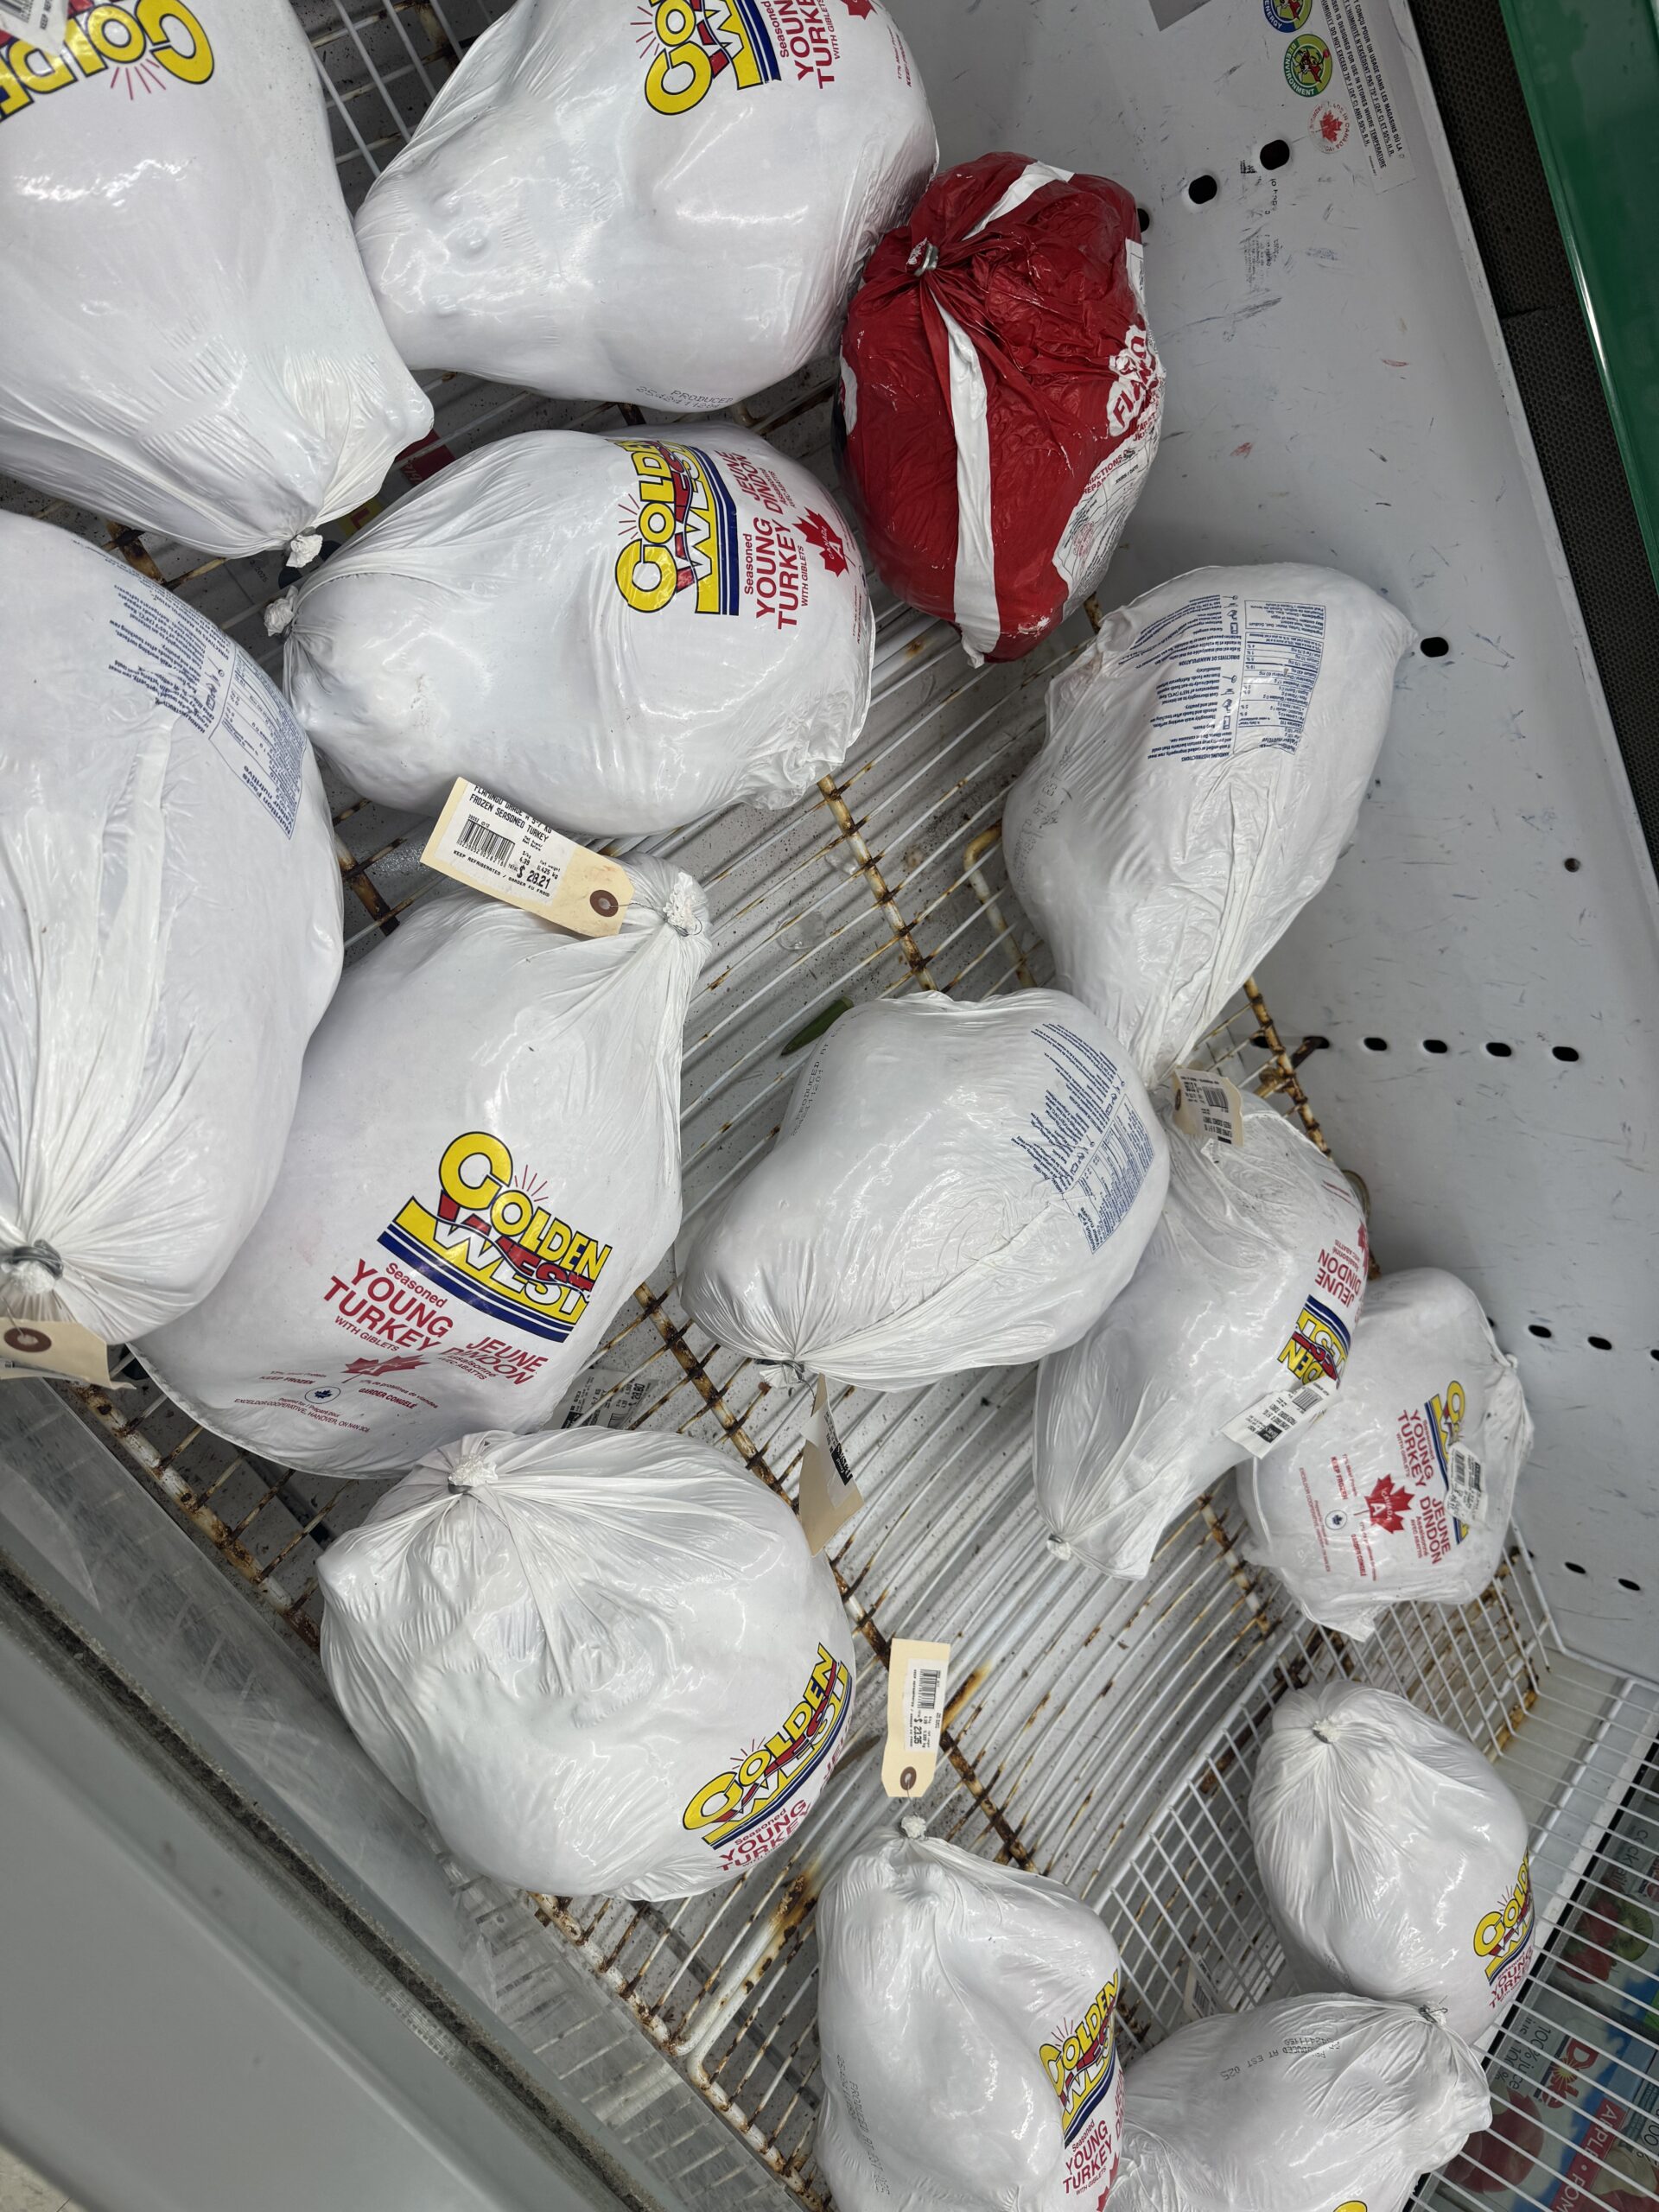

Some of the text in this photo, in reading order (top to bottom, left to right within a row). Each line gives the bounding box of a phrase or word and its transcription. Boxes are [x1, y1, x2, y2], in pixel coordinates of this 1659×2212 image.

[760, 0, 790, 58] Seasoned
[772, 0, 814, 80] YOUN
[830, 34, 840, 60] WITH
[1329, 26, 1338, 36] DO
[1332, 36, 1341, 49] NOT
[1338, 21, 1351, 50] DESIGNED
[1336, 49, 1348, 72] EXCEED
[1346, 50, 1356, 64] FOR
[1350, 64, 1358, 76] USE
[1353, 3, 1402, 151] CONÇU POUR UN USAGE DANS LES MAGASINS OÙ LA
[1353, 107, 1363, 120] AND
[1356, 84, 1368, 107] STORES
[1365, 74, 1374, 87] PAS
[1379, 122, 1387, 130] ET
[1363, 107, 1374, 129] WHERE
[1369, 128, 1386, 168] TEMPERATURE
[733, 454, 783, 513] DINDON
[822, 525, 835, 559] CANADA
[744, 533, 753, 595] Seasoned
[753, 517, 776, 619] YOUNG
[773, 518, 800, 630] TURKEY
[798, 545, 808, 581] GIBLETS
[120, 624, 144, 643] touching
[129, 613, 151, 629] internal
[137, 643, 160, 660] working
[144, 640, 158, 652] after
[158, 649, 173, 661] hands
[160, 642, 181, 660] poultry.
[164, 636, 192, 660] thoroughly
[1178, 656, 1211, 665] MANIPULATION
[1217, 652, 1239, 662] DIRECTIVES
[242, 765, 273, 799] nutritive
[241, 772, 291, 835] Nutrition Facts
[468, 793, 549, 842] FROZEN SEASONED TURKEY
[453, 849, 466, 859] KEEP
[467, 855, 501, 877] REFRIGERATED
[515, 864, 551, 891] $ 28.21
[518, 855, 531, 867] 4.39
[439, 1131, 613, 1282] GOLDEN
[436, 1191, 594, 1313] WEST
[385, 1262, 448, 1308] Seasoned
[1314, 1268, 1354, 1307] JEUNE
[1318, 1249, 1360, 1294] DINDON
[322, 1276, 441, 1352] TURKEY
[350, 1260, 454, 1337] YOUNG
[334, 1315, 398, 1352] WITH GIBLETS
[454, 1362, 487, 1381] ABATTIS
[466, 1334, 548, 1373] JEUNE
[358, 1385, 417, 1410] GARDER CONGELÉ
[338, 1419, 347, 1427] ON
[1397, 1409, 1426, 1488] TURKEY
[1408, 1409, 1434, 1480] YOUNG
[1370, 1500, 1384, 1516] A
[1380, 1489, 1392, 1521] CANADA
[1409, 1518, 1423, 1559] AVEC ABATTIS
[1419, 1496, 1443, 1564] DINDON
[1429, 1496, 1453, 1554] JEUNE
[683, 1643, 839, 1830] GOLDEN
[715, 1661, 845, 1821] WEST
[719, 1799, 807, 1861] YOUNG
[734, 1808, 786, 1846] Seasoned
[1039, 1971, 1120, 2098] GOLDEN
[1218, 2049, 1279, 2081] AT EST 025
[1065, 2120, 1109, 2176] YOUNG
[1072, 2119, 1096, 2152] Seasoned
[1063, 2135, 1113, 2196] TURKEY
